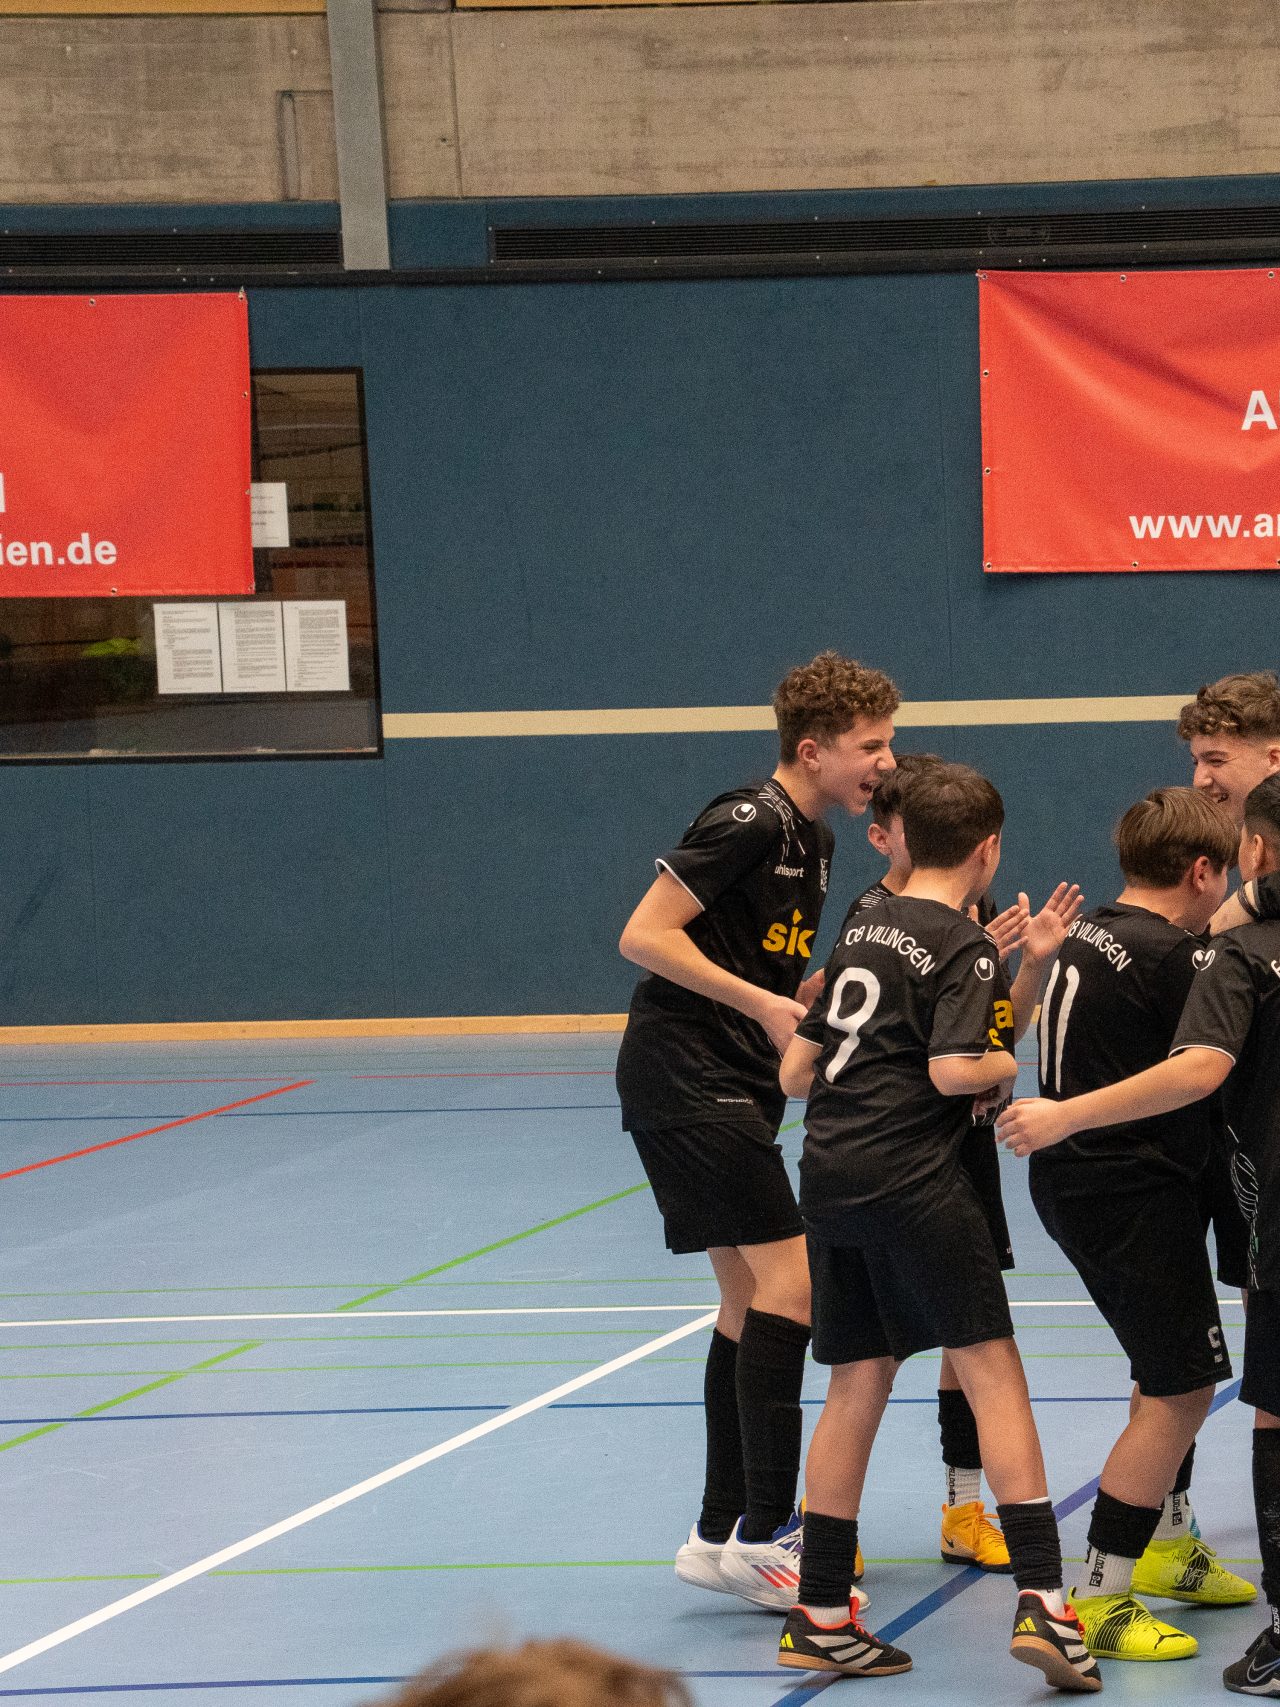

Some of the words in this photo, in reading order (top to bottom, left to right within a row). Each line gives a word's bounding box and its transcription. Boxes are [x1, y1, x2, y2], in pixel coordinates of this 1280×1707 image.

[774, 864, 805, 878] uhlsport
[845, 926, 866, 946] 08
[865, 925, 936, 976] VILLINGEN
[1076, 921, 1133, 972] VILLINGEN
[825, 967, 881, 1083] 9
[1040, 958, 1080, 1093] 11
